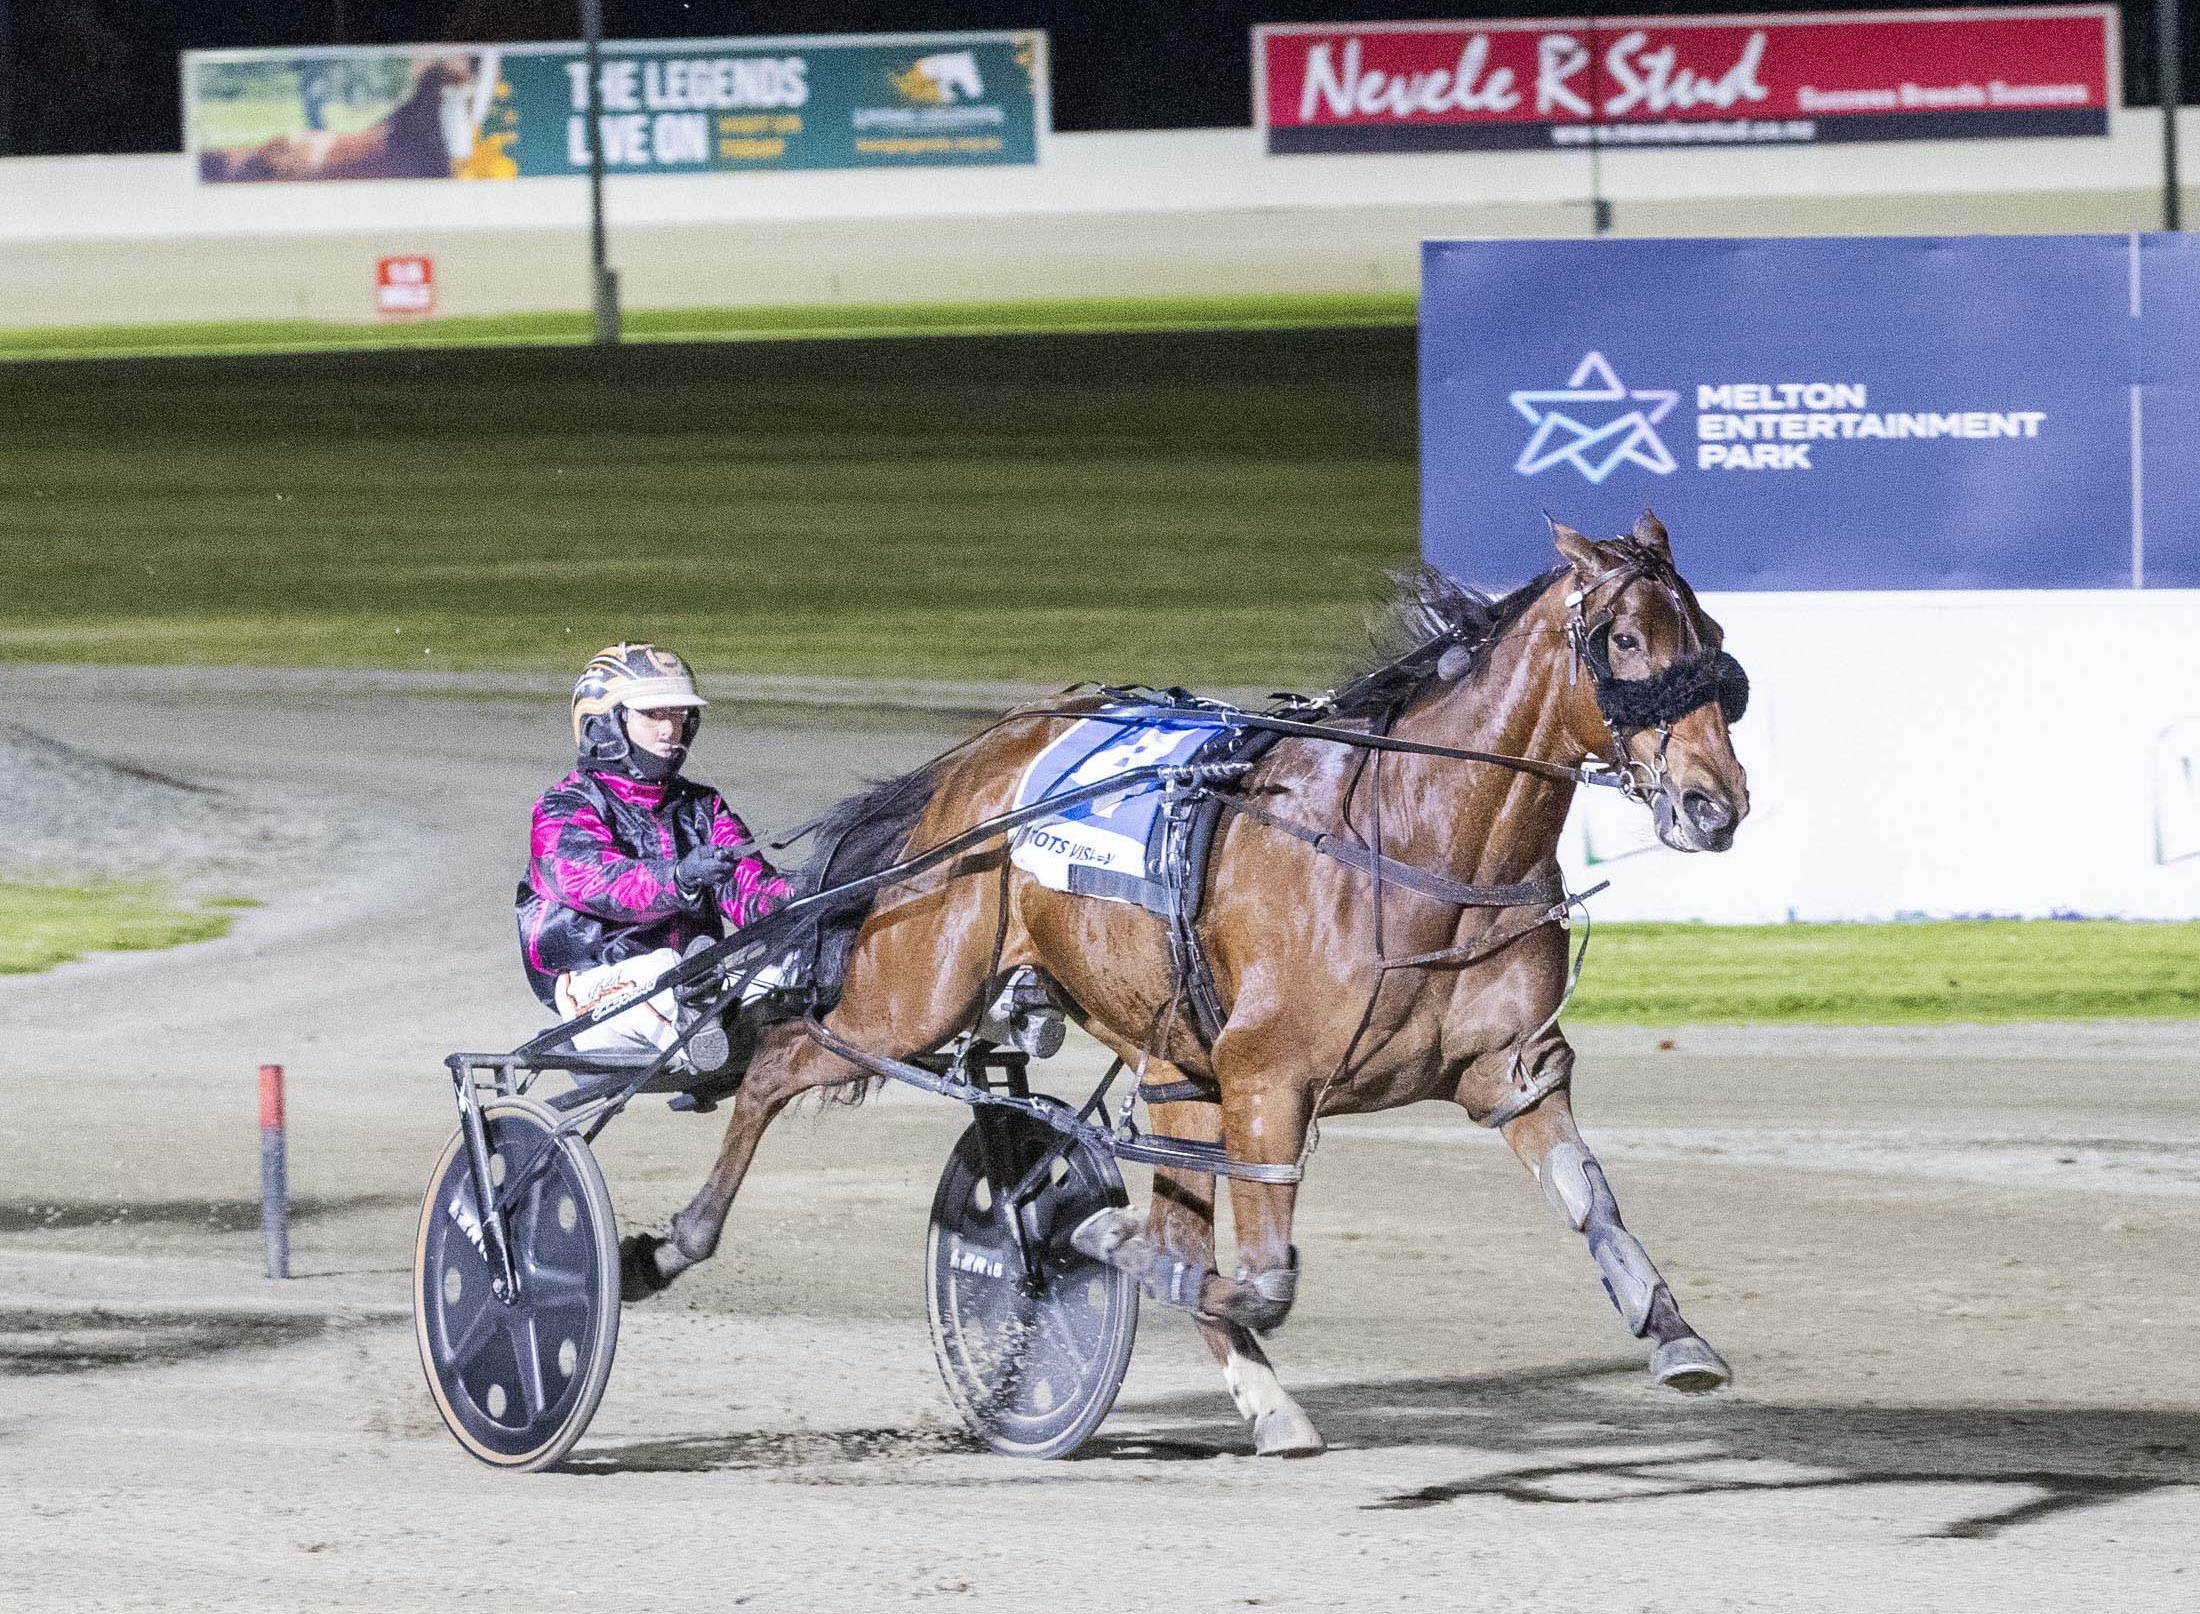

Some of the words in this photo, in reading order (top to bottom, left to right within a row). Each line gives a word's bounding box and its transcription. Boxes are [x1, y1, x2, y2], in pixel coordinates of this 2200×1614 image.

[644, 57, 809, 110] LEGENDS
[1300, 34, 1521, 121] Nevele
[1538, 34, 1590, 117] R
[1605, 32, 1767, 116] Stud
[567, 114, 648, 166] LVE
[653, 113, 709, 164] ON
[1697, 383, 1867, 411] MELTON
[1697, 411, 2046, 440] ENTERTAINMENT
[1697, 443, 1813, 471] PARK
[1028, 829, 1070, 854] OTS
